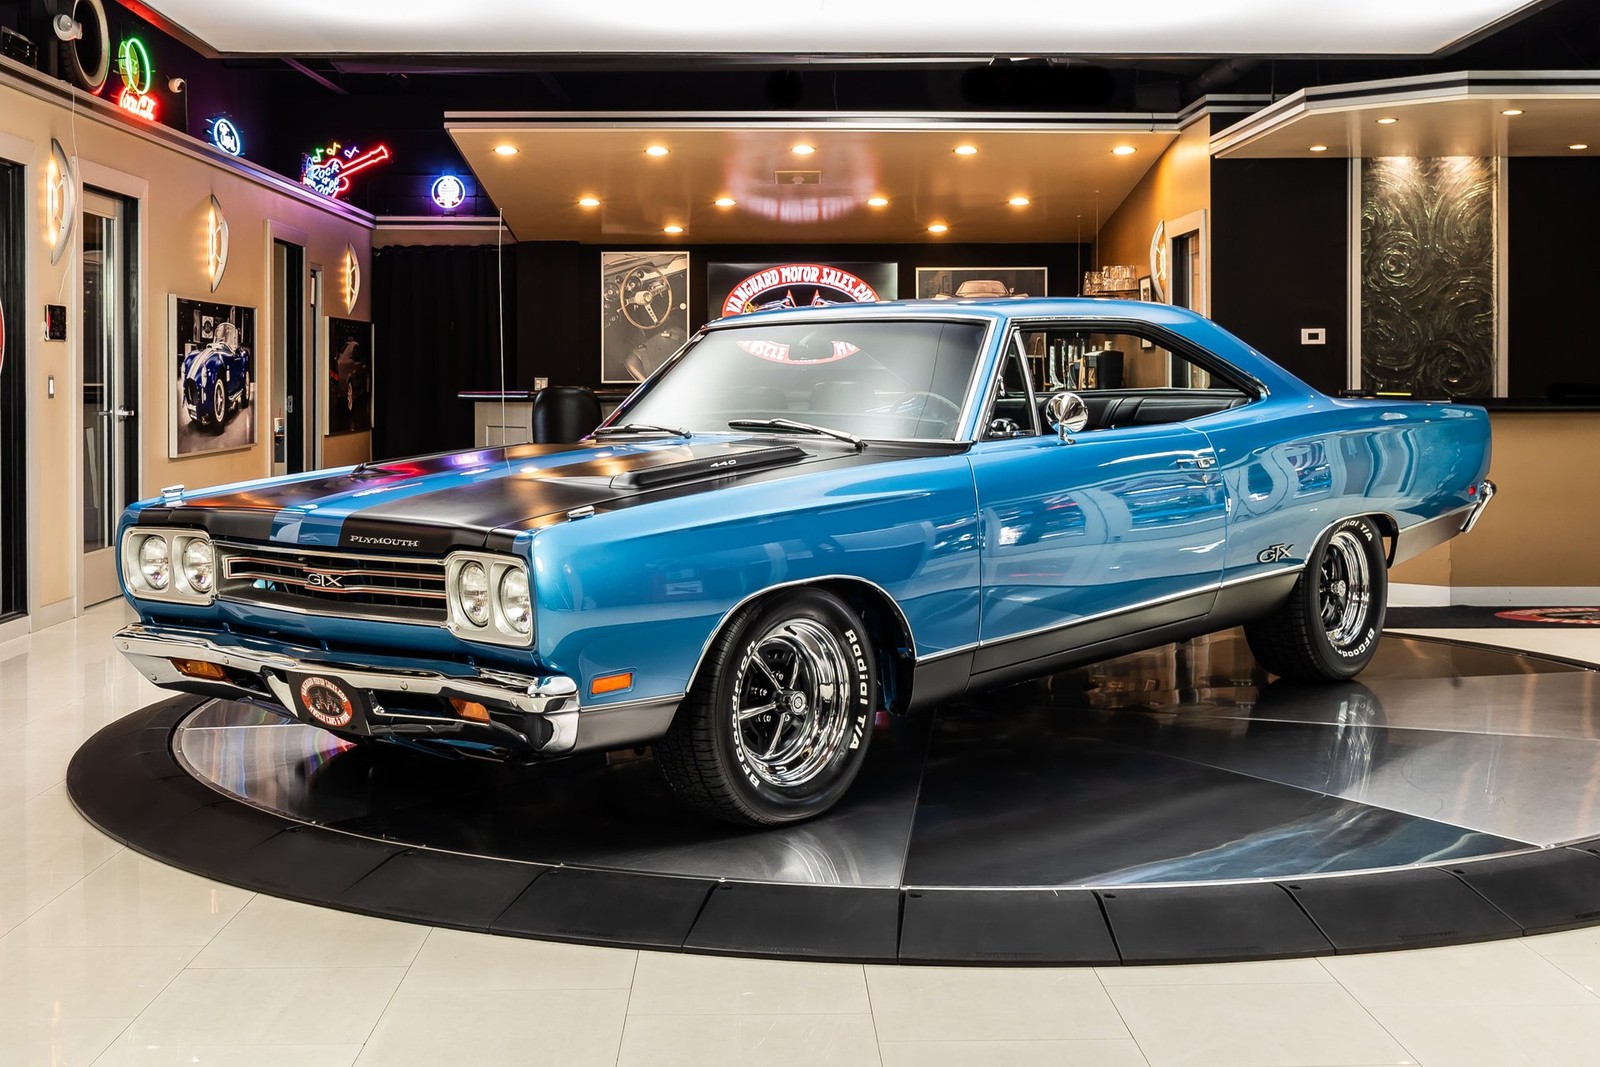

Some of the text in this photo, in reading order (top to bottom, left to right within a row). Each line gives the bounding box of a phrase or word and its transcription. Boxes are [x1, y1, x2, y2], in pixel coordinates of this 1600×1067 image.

[308, 160, 340, 181] Rock
[726, 269, 780, 313] VANGUARD
[780, 266, 820, 283] MOTOR
[710, 459, 737, 468] 440
[350, 535, 419, 547] PLYMOUTH
[1360, 523, 1373, 542] T/A
[1257, 543, 1294, 564] GTX
[307, 573, 343, 587] GTX
[845, 628, 870, 750] Radial T/A
[732, 640, 761, 788] BFGoodrich
